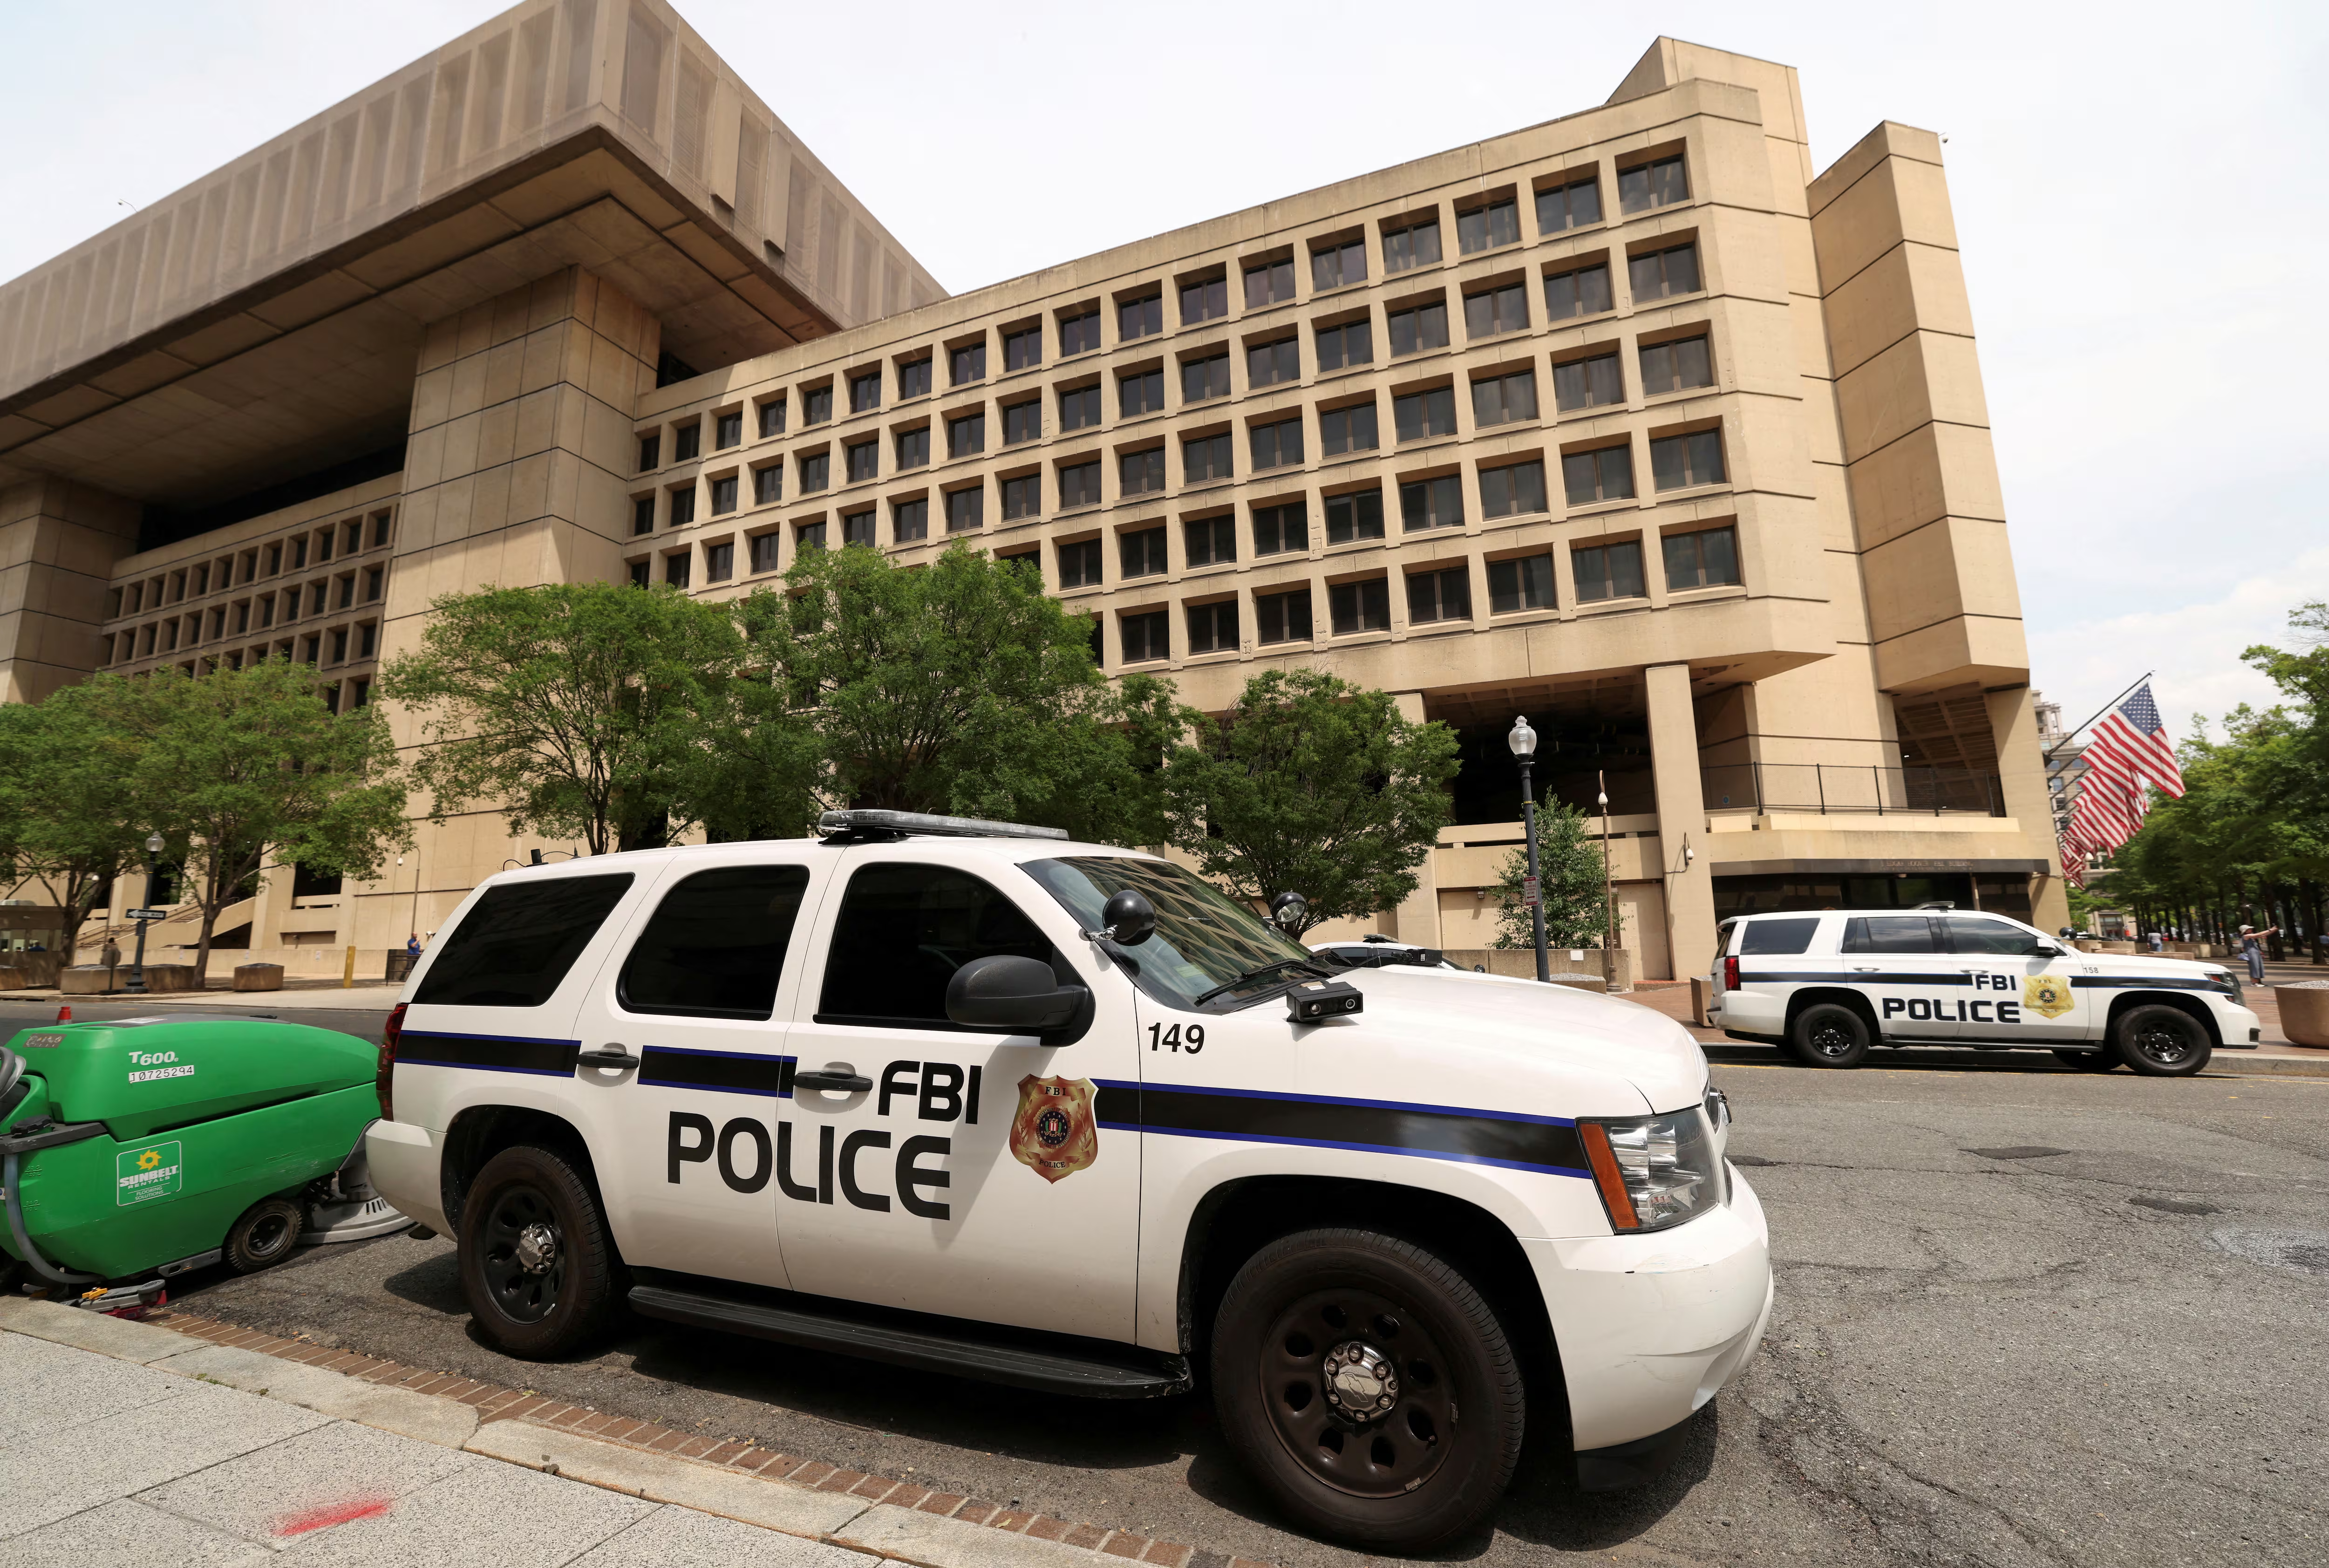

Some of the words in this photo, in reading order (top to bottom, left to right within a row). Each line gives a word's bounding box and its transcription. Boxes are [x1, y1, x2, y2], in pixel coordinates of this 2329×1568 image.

[1975, 975, 2016, 990] FBI
[1882, 998, 2021, 1023] POLICE
[1148, 1022, 1205, 1054] 149
[130, 1066, 193, 1082] 10725294
[878, 1060, 982, 1125] FBI
[1045, 1086, 1066, 1096] FBI
[1037, 1107, 1056, 1120] DEPARTMENT
[1061, 1111, 1070, 1123] JUSTICE
[1057, 1126, 1071, 1148] INVESTIGATION
[667, 1111, 951, 1221] POLICE
[1039, 1159, 1066, 1168] POLICE
[119, 1165, 178, 1187] SUNBELT
[128, 1175, 170, 1189] RENTALS
[135, 1190, 164, 1200] SOLUTIONS
[136, 1186, 163, 1196] FLOORING
